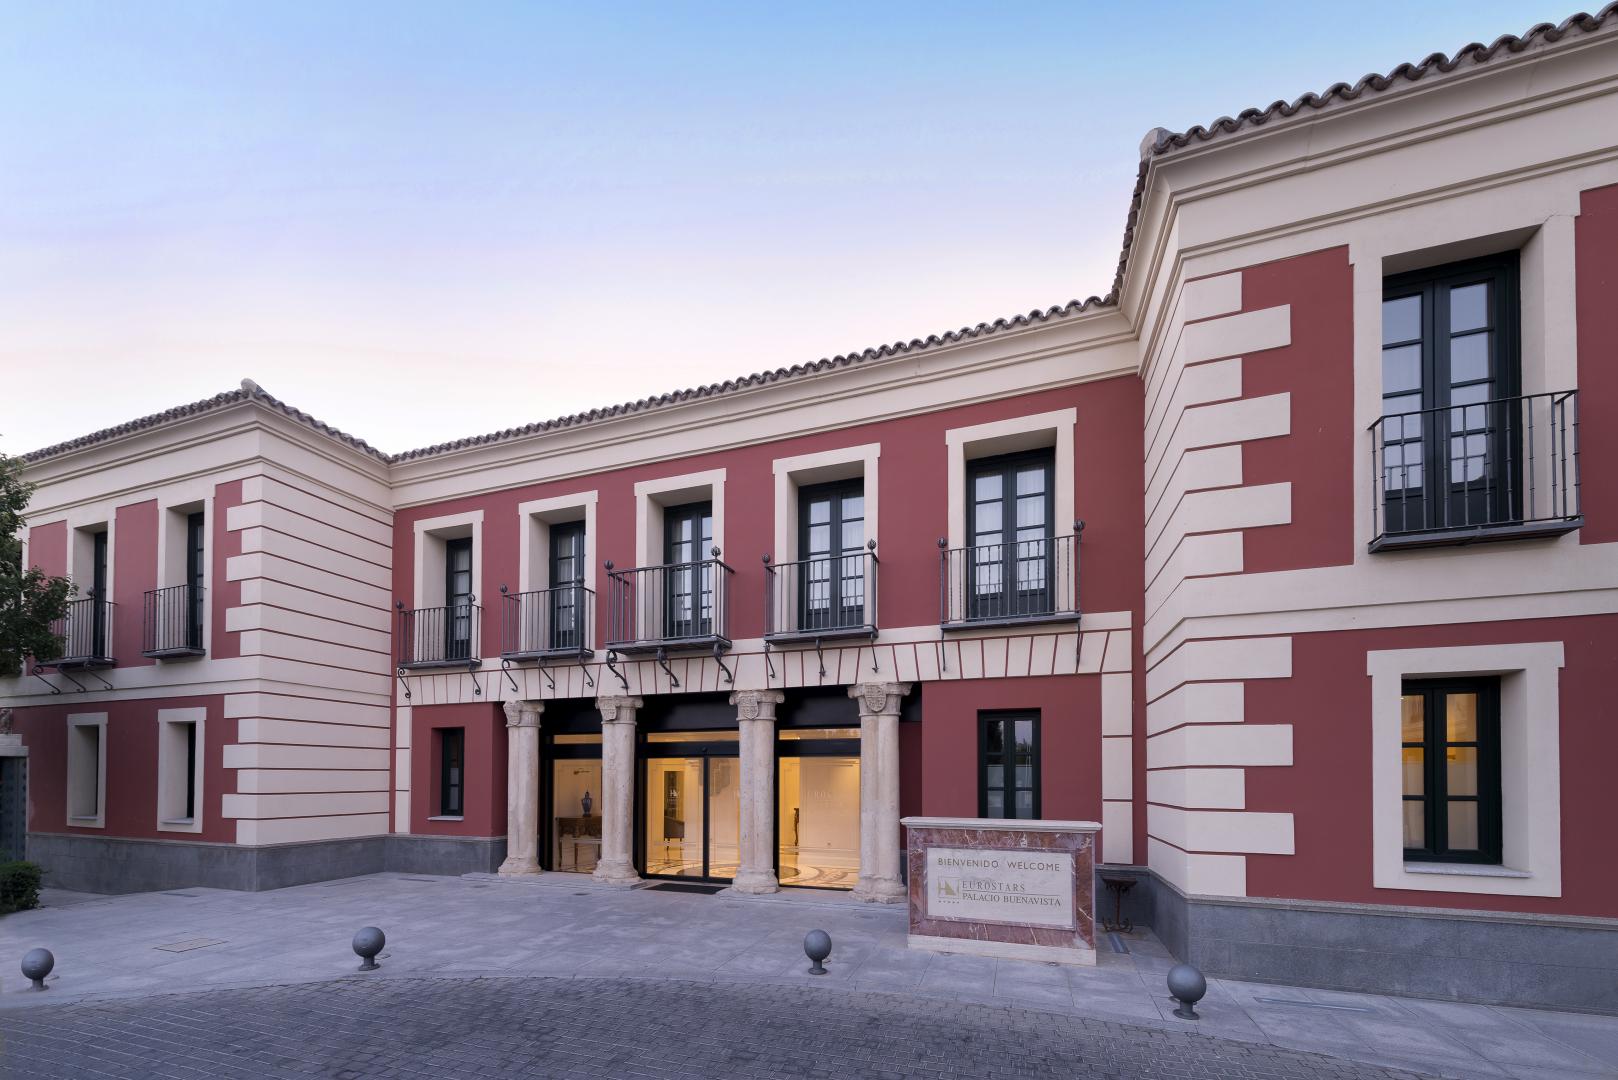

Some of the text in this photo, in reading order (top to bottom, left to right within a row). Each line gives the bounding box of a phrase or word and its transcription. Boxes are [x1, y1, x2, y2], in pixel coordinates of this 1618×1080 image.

[938, 857, 1060, 872] BIENVENIDO WELCOME
[962, 880, 1025, 892] EUROSTARS
[962, 892, 1061, 907] PALACIO BUENAVISTA
